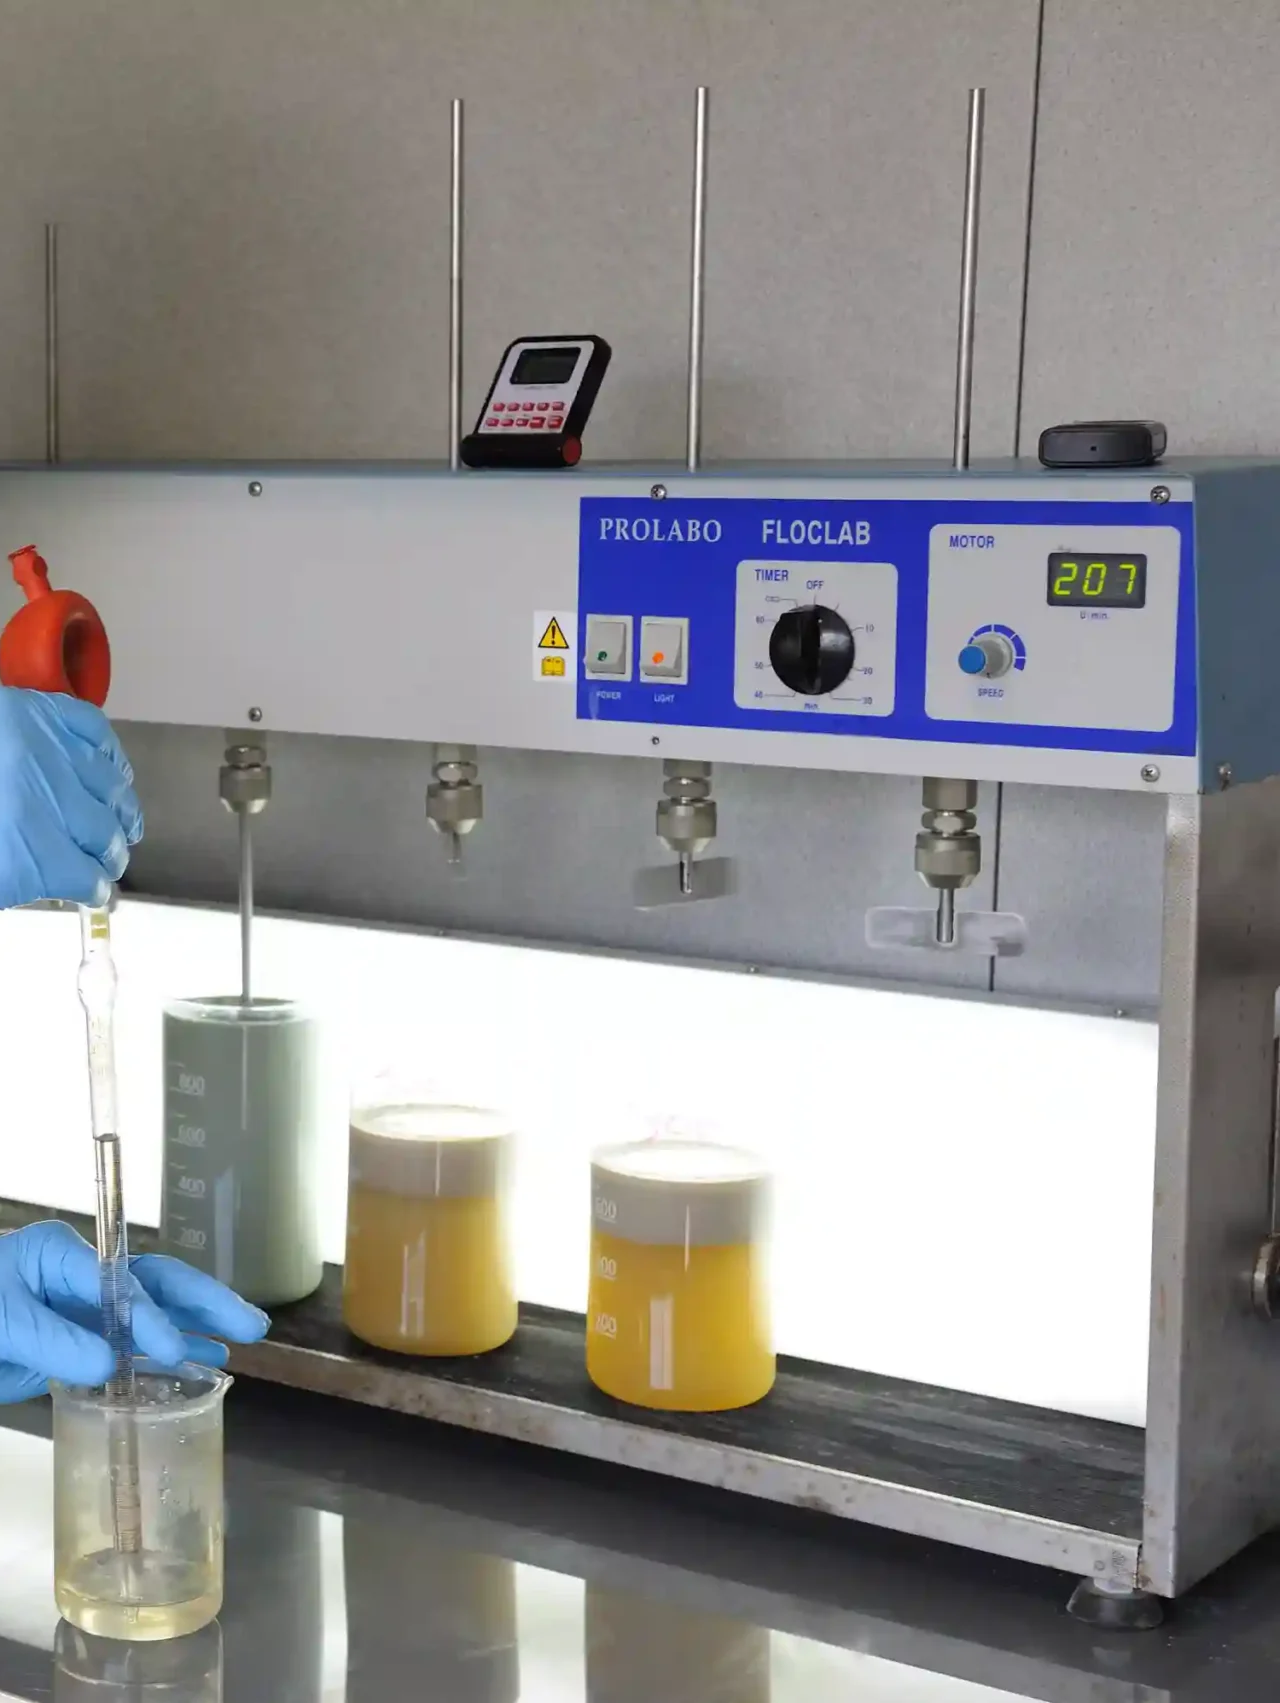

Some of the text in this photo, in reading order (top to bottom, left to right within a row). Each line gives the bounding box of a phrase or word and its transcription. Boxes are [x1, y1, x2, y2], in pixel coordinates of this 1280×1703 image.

[599, 518, 722, 542] PROLABO
[761, 519, 871, 545] FLOCLAB
[949, 535, 995, 548] MOTOR
[755, 569, 789, 581] TIMER
[1053, 563, 1137, 595] 207
[806, 580, 824, 590] OFF
[865, 624, 874, 633] 10
[863, 666, 873, 675] 20
[596, 690, 622, 700] POWER
[654, 693, 675, 703] LIGHT
[978, 688, 1004, 698] SPEED
[177, 1124, 205, 1146] 600
[178, 1174, 205, 1196] 400
[180, 1226, 207, 1246] 200
